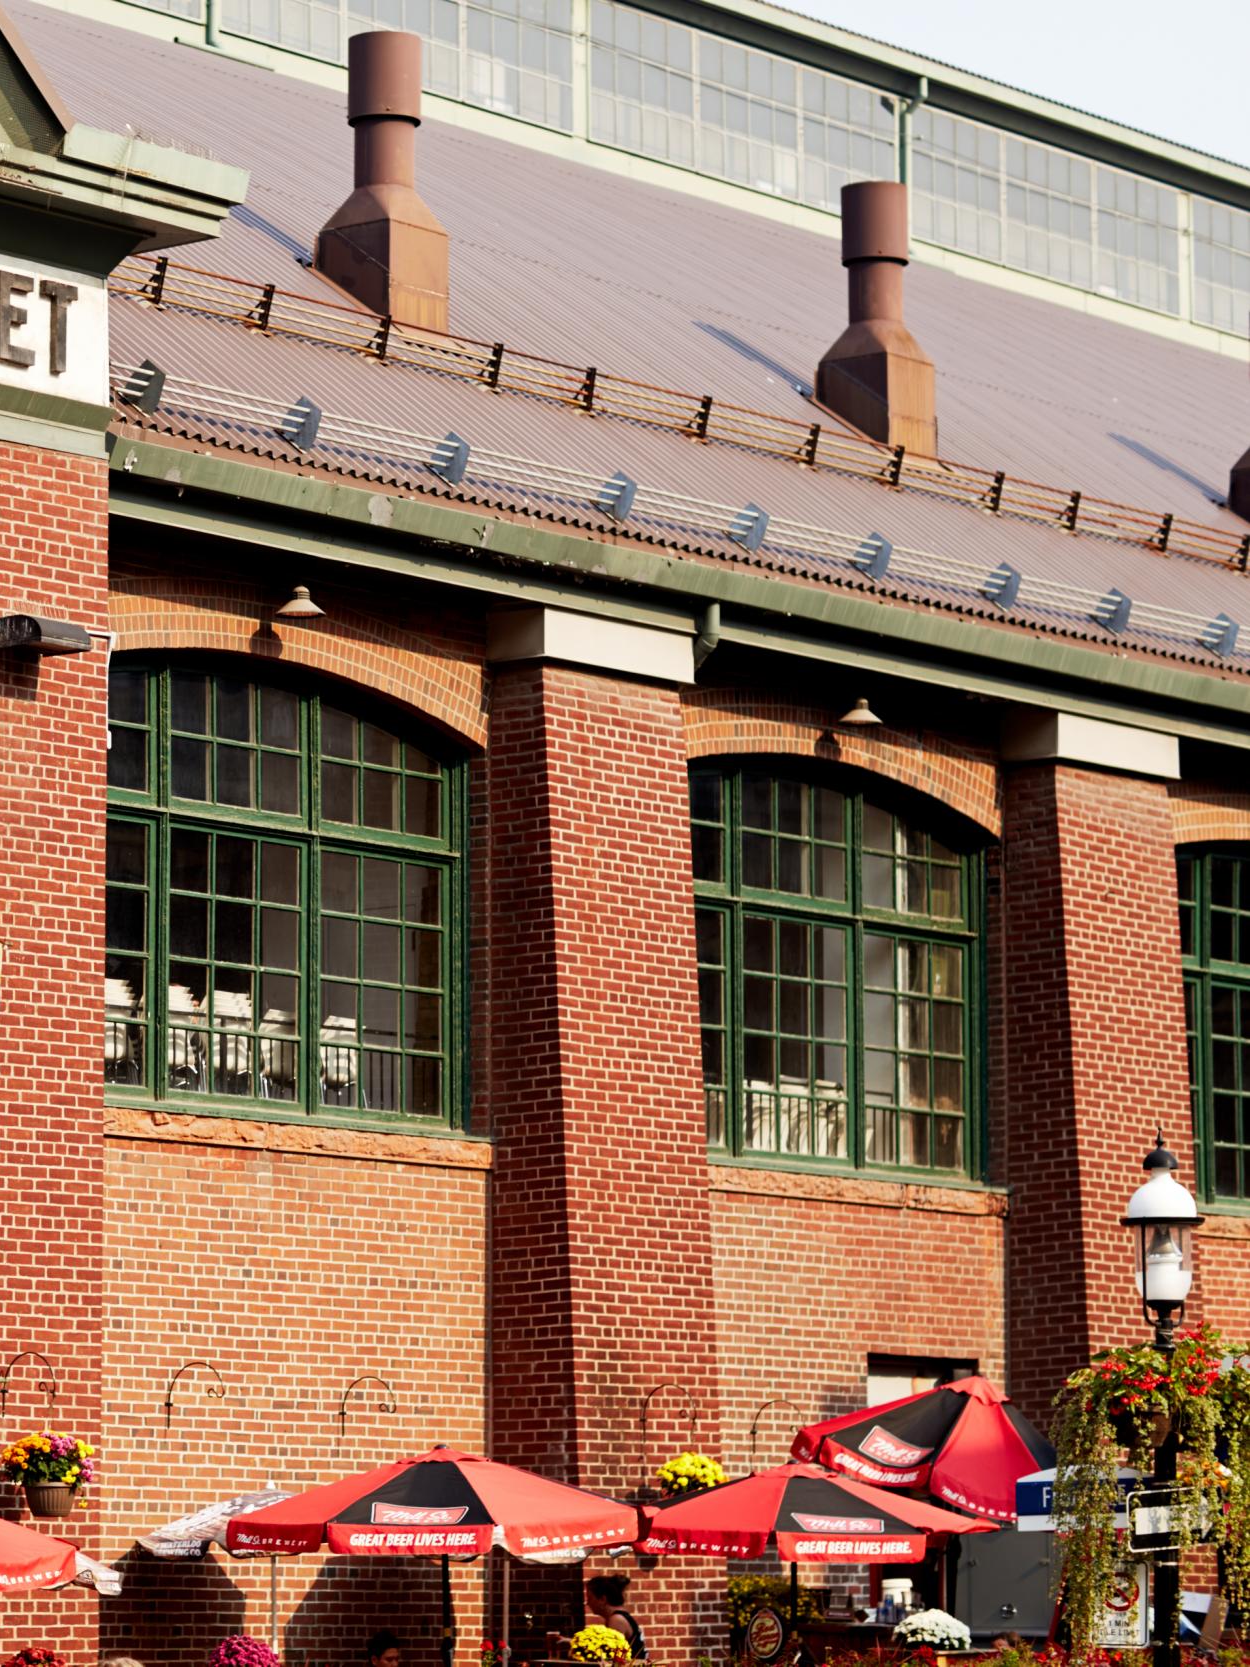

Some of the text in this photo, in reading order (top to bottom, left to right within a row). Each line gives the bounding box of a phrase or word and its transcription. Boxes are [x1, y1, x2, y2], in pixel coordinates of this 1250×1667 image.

[349, 1532, 478, 1547] GREAT BEER LIVES HERE.
[552, 1528, 626, 1544] BREWERY
[679, 1542, 749, 1554] BREWERY
[795, 1541, 913, 1555] GREAT BEER LIVES HERE.
